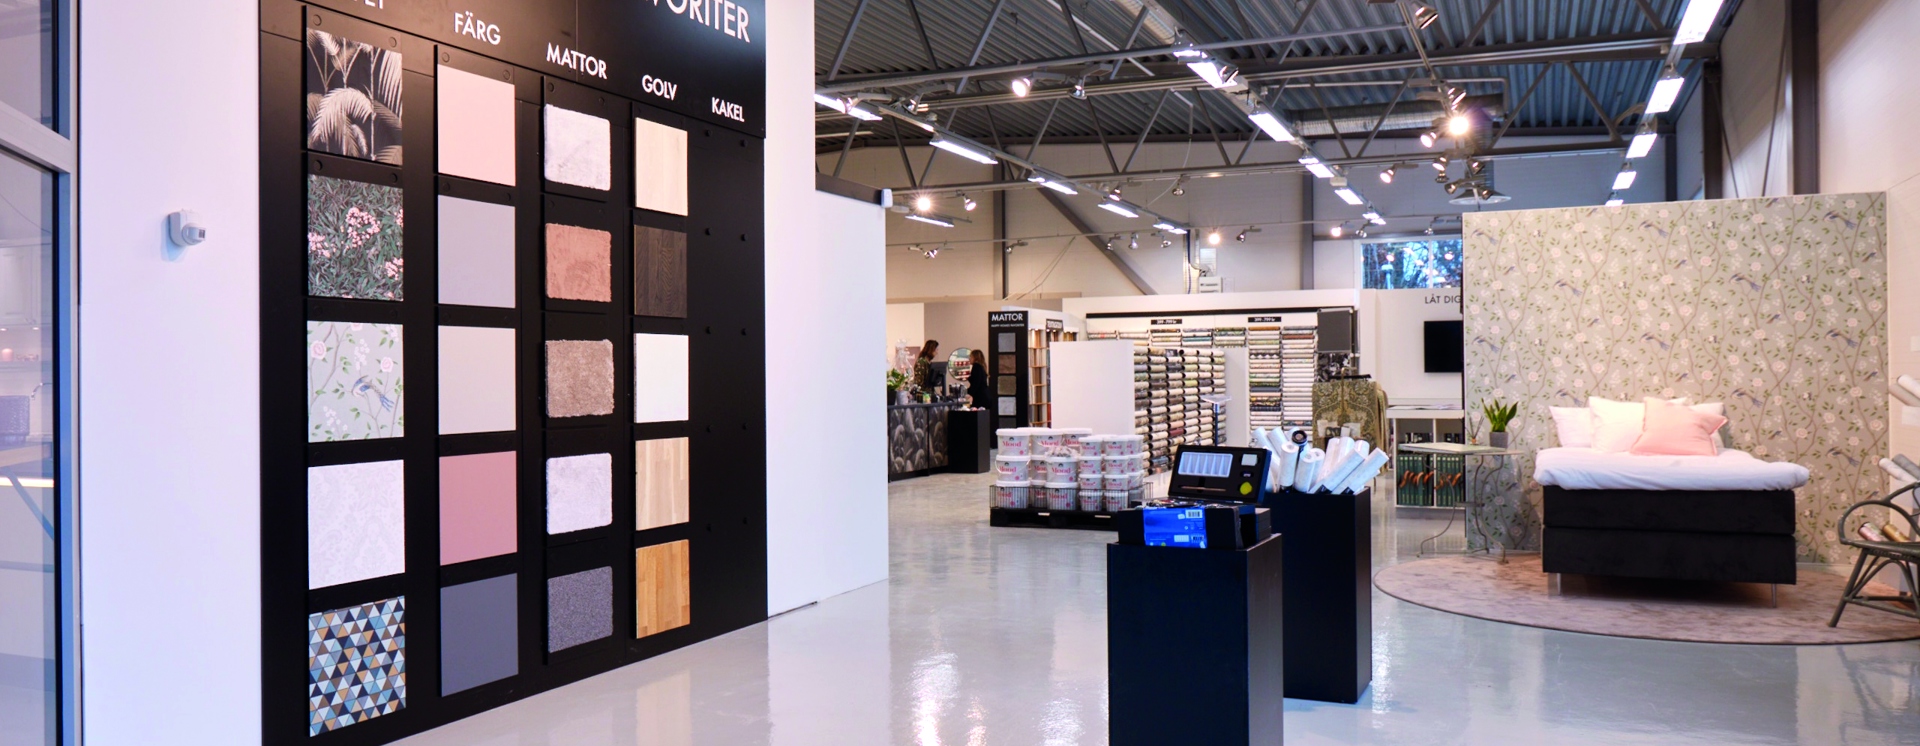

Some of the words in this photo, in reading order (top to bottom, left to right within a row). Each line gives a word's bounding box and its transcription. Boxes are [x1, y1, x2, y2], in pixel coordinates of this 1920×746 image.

[454, 11, 501, 45] FÄRG
[546, 43, 607, 79] MATTOR
[642, 75, 678, 100] GOLV
[711, 97, 745, 122] KAKEL
[1425, 294, 1441, 304] LÅT
[991, 313, 1023, 321] MATTOR
